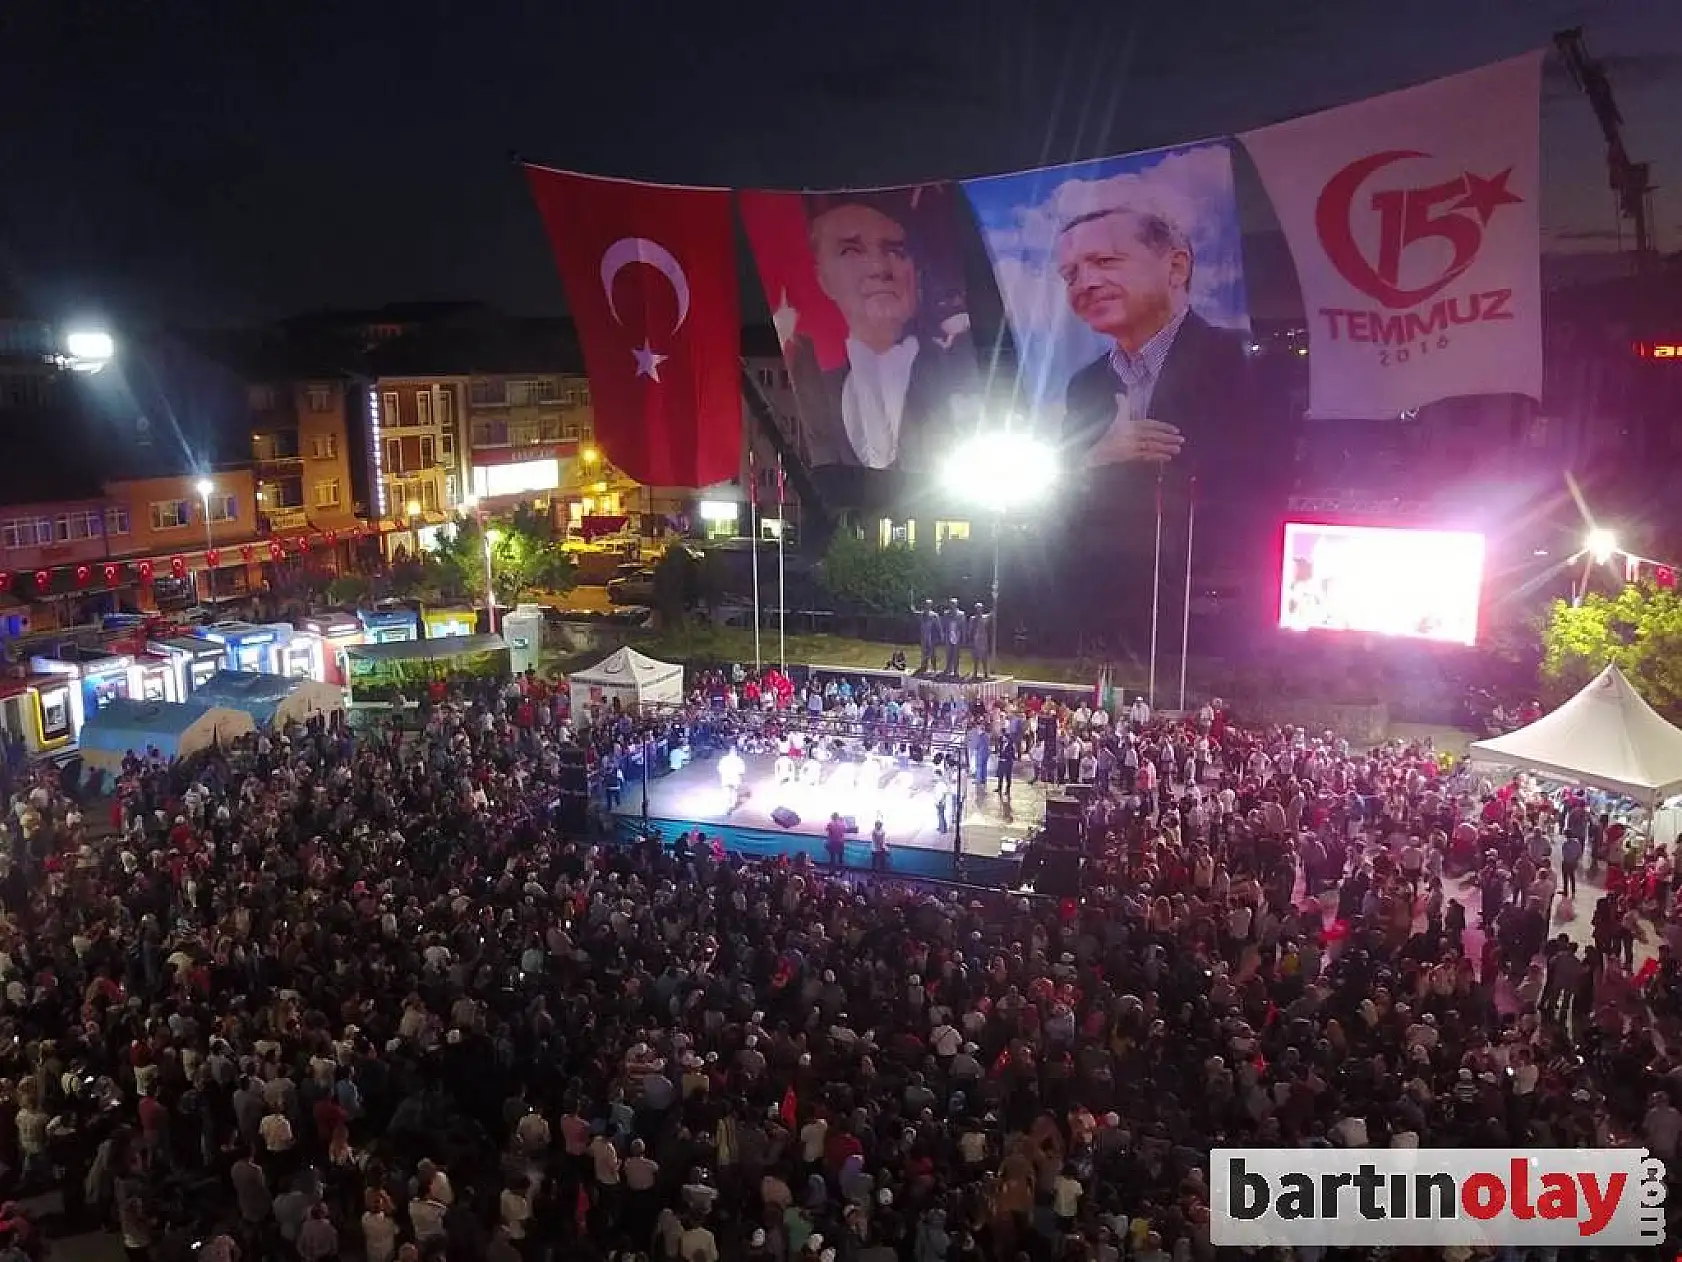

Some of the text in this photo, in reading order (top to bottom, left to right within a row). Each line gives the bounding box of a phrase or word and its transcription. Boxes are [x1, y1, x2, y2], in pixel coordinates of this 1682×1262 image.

[1372, 177, 1482, 288] 15
[1319, 288, 1514, 345] TEMMUZ
[1380, 335, 1452, 367] 2016
